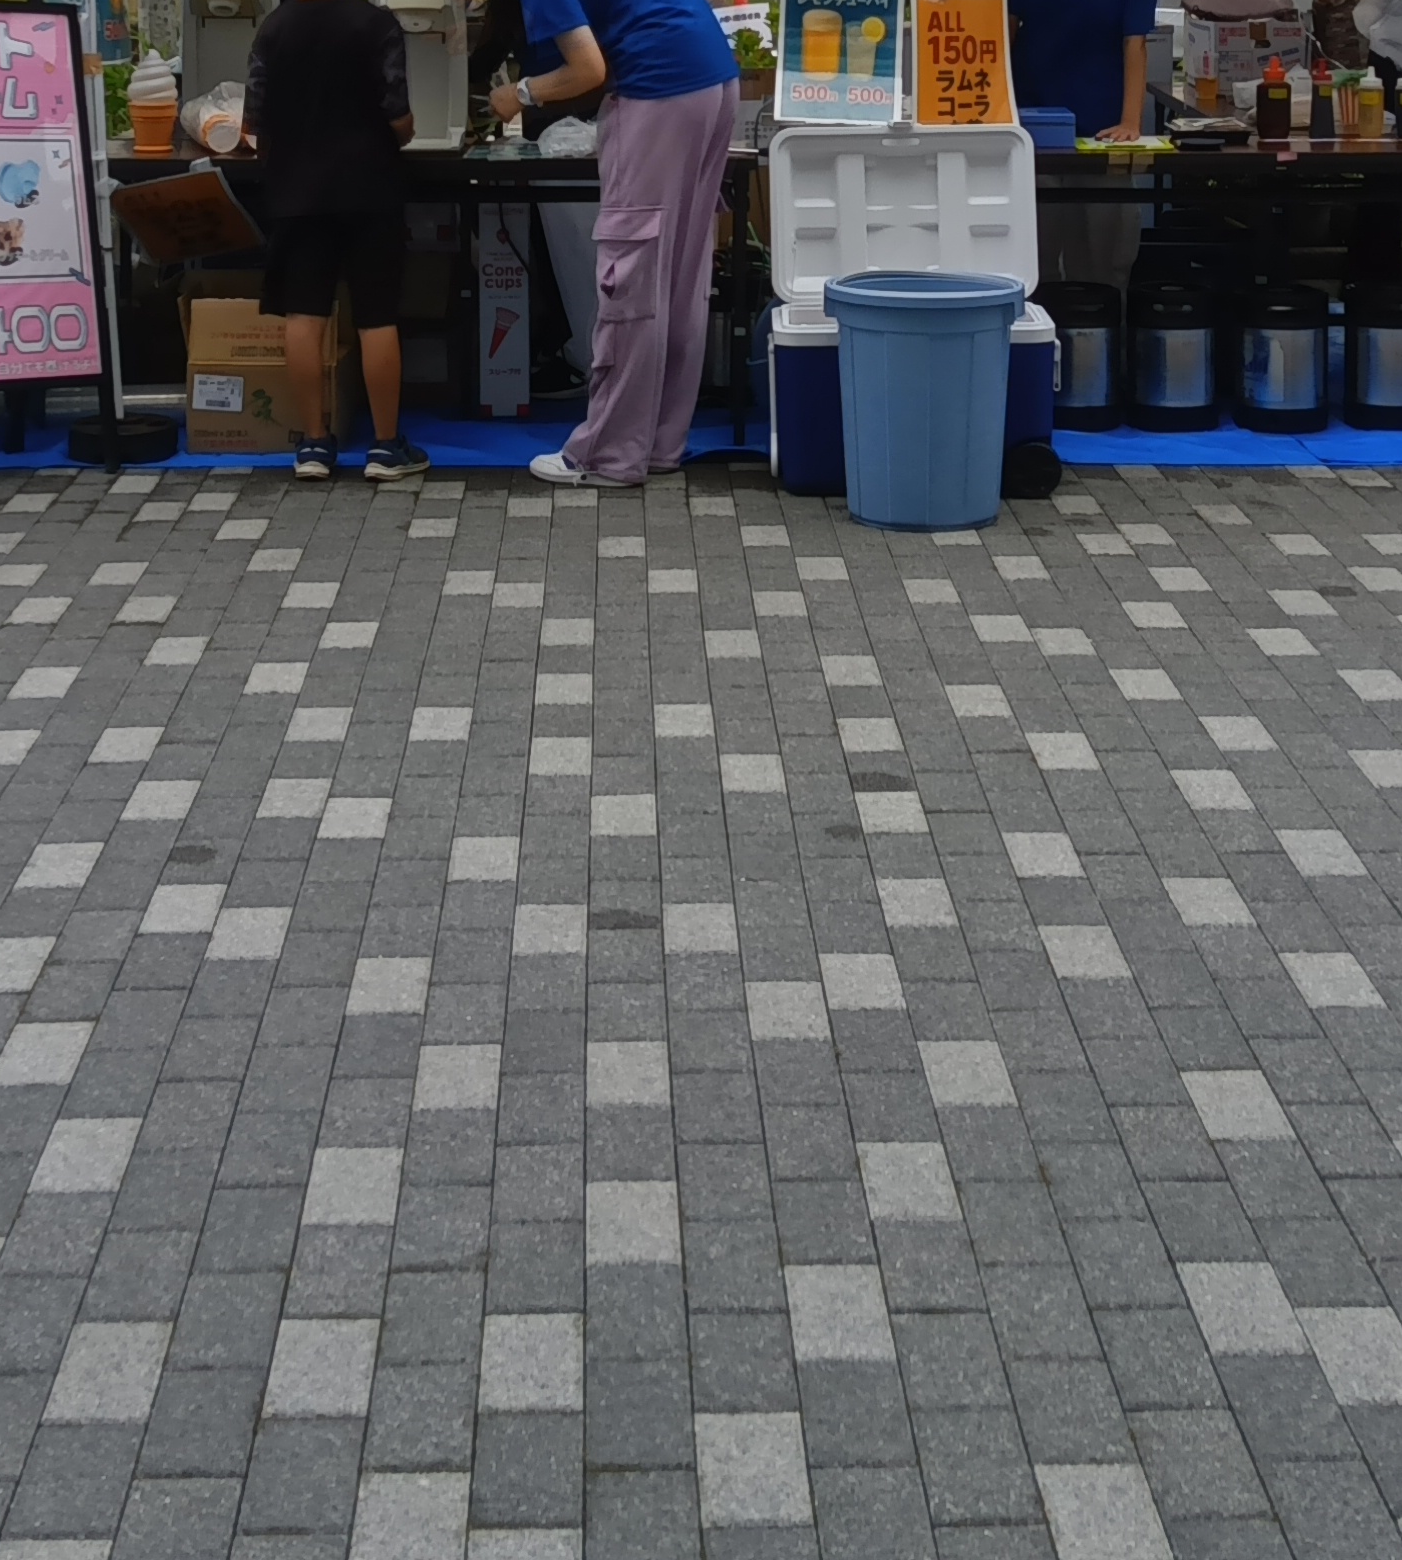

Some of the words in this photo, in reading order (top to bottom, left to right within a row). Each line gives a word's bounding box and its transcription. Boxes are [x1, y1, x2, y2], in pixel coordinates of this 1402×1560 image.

[927, 11, 966, 32] ALL
[927, 35, 997, 65] 150円
[935, 68, 992, 93] ラムネ
[937, 94, 991, 117] コーラ
[481, 263, 525, 277] Cone
[484, 277, 523, 291] cups
